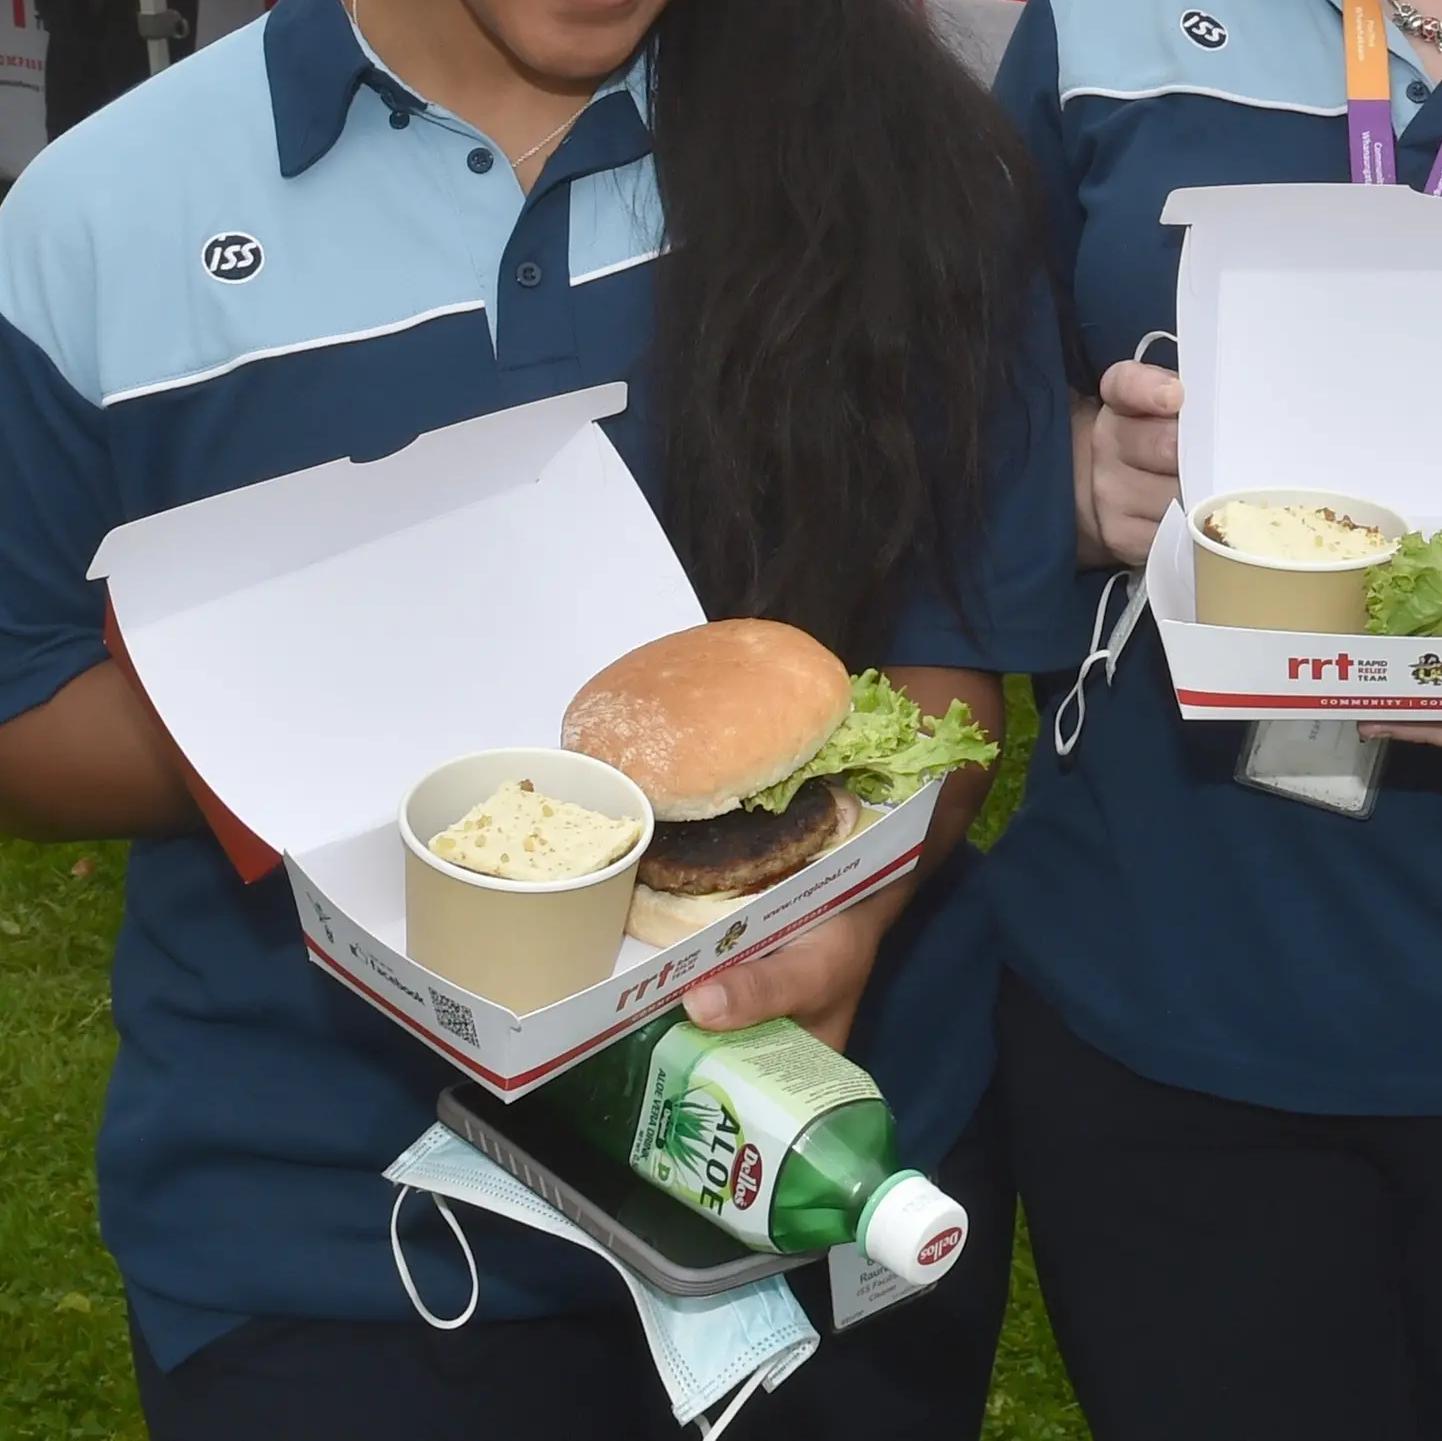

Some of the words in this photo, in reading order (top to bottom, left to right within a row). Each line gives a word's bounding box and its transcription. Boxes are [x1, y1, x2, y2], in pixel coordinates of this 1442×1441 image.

[1288, 653, 1354, 681] rrt
[1357, 659, 1388, 667] RAPID
[1357, 674, 1388, 682] TEAM
[1320, 698, 1402, 707] COMMUNITY
[762, 857, 862, 923] www.rrtglobal.org
[616, 960, 676, 1013] rrt
[655, 1068, 667, 1099] ALOE
[650, 1099, 662, 1126] VERA
[642, 1123, 656, 1162] DRINK
[700, 1103, 741, 1216] ALOE
[733, 1146, 759, 1205] Dellos
[918, 1231, 960, 1261] Dellos
